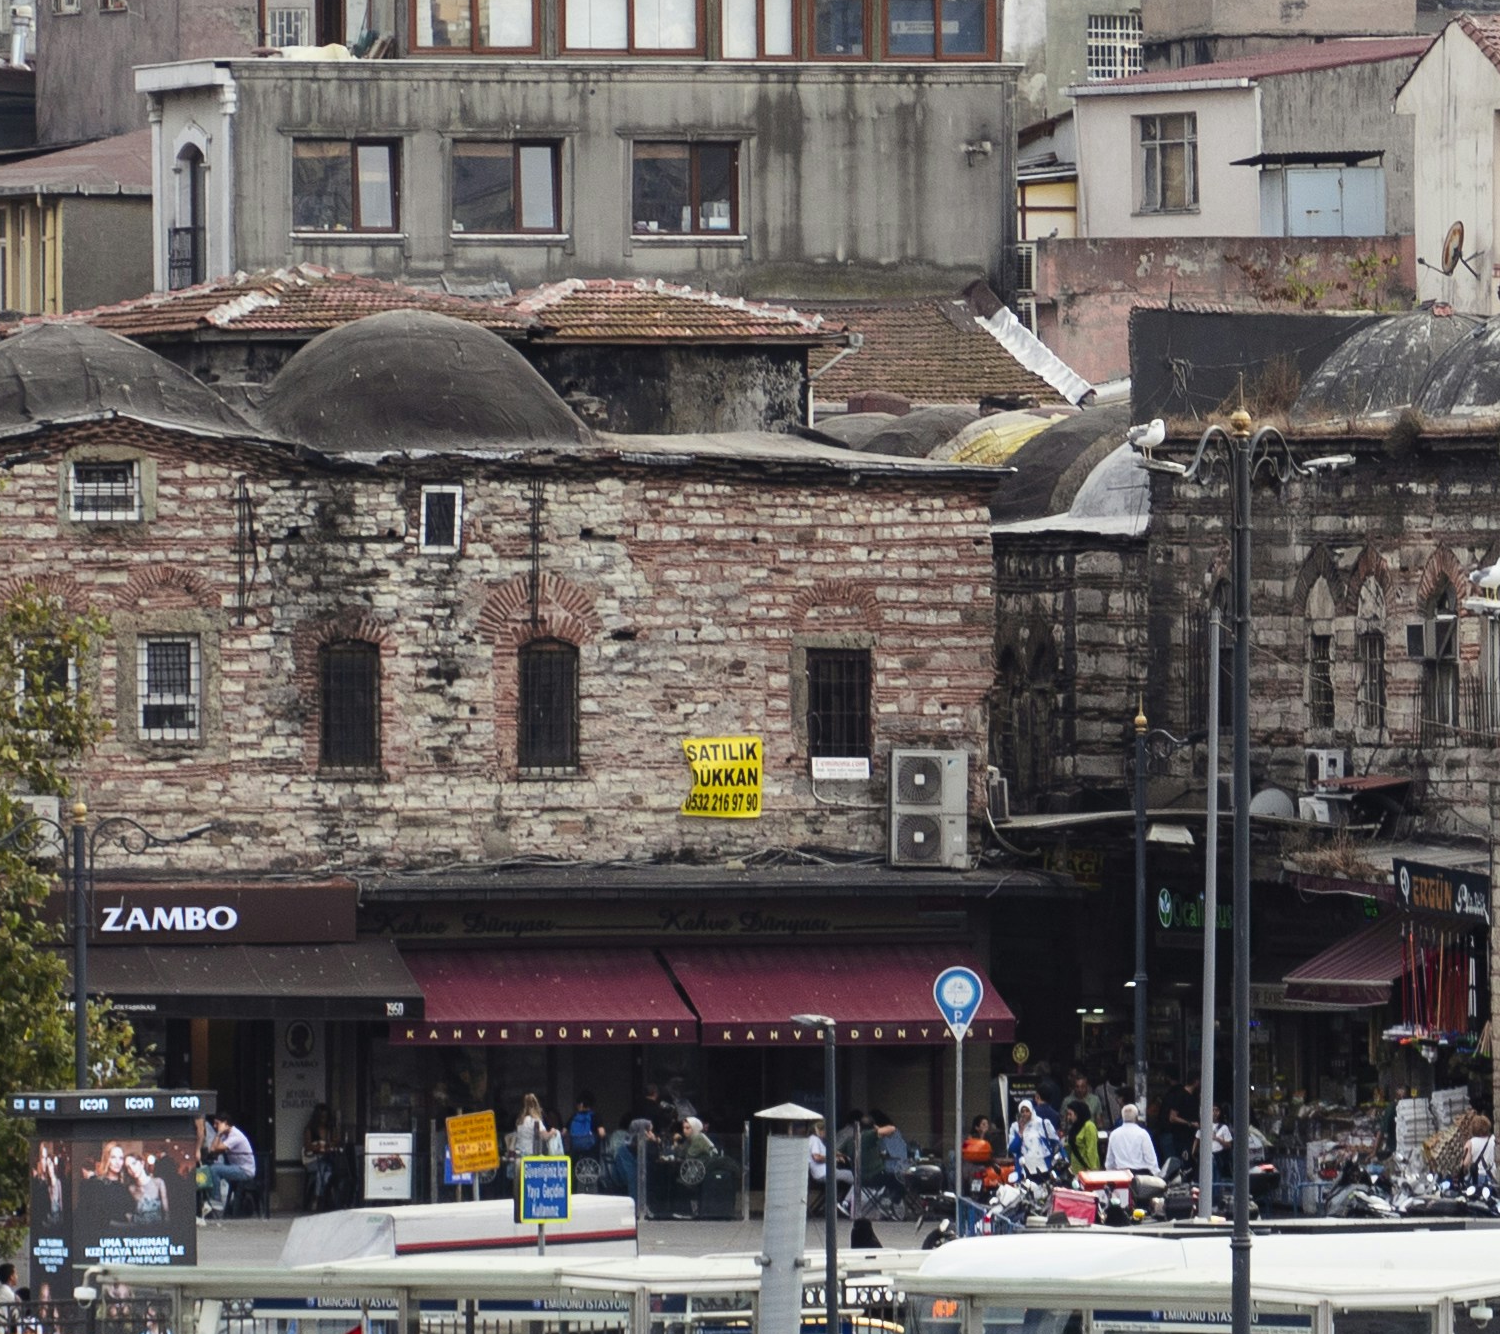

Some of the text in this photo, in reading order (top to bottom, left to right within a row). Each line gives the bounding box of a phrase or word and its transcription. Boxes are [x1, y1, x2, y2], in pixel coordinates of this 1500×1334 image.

[687, 743, 758, 762] SATILIK
[711, 794, 729, 812] 216
[732, 794, 743, 811] 97
[746, 794, 758, 811] 90
[1411, 873, 1453, 911] ERGÜN
[101, 897, 238, 932] ZAMBO
[374, 911, 557, 937] Kahve Dünyası
[658, 908, 831, 936] Kahve Dünyası
[406, 1025, 680, 1040] KAHVE DÜNYASI
[99, 1238, 122, 1248] UMA
